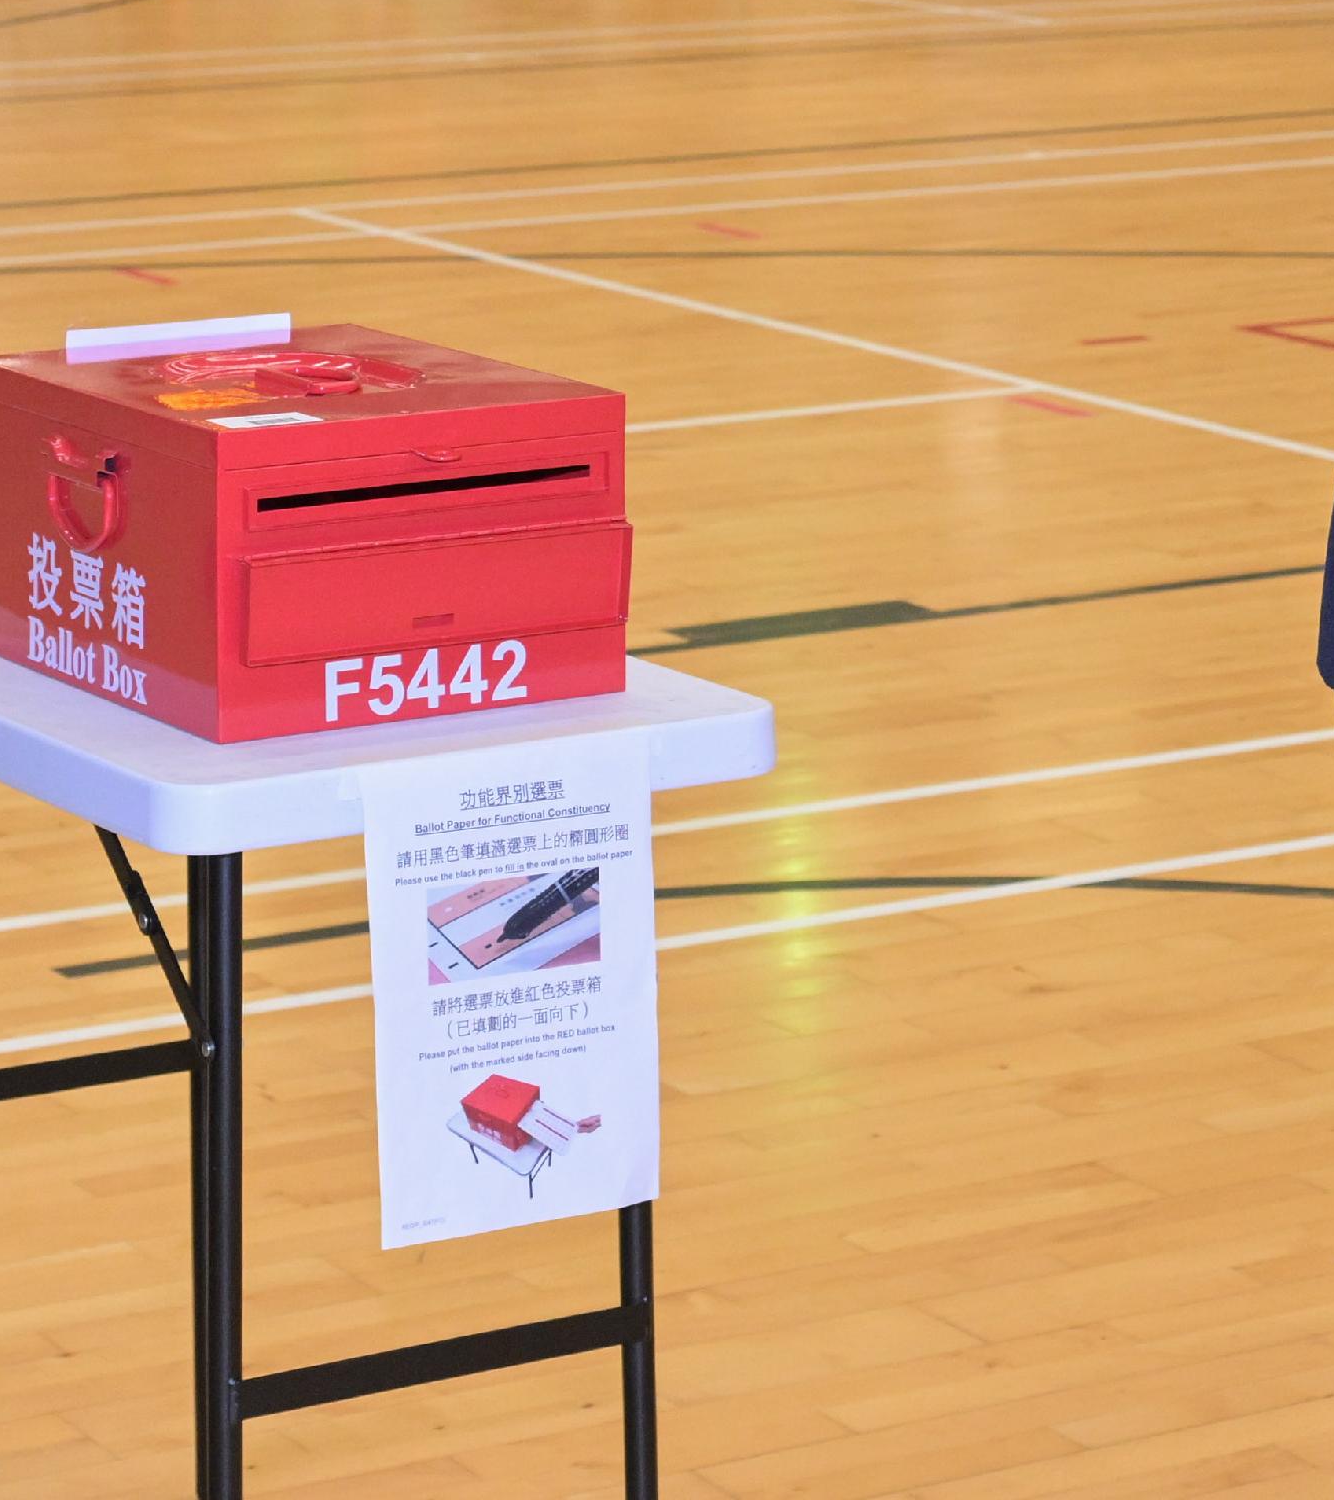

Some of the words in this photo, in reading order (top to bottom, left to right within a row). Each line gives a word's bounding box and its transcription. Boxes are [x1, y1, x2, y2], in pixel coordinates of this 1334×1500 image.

[27, 532, 147, 650] 投票箱
[27, 615, 97, 686] Ballot
[101, 644, 148, 705] Box
[324, 639, 528, 722] F5442
[459, 779, 565, 809] 功能界別選票
[414, 821, 445, 835] Ballot
[446, 818, 476, 832] Paper
[478, 816, 492, 826] for
[494, 810, 546, 825] Functional
[547, 802, 611, 818] Constituency
[395, 877, 422, 887] Please
[440, 872, 454, 881] the
[456, 868, 476, 879] black
[478, 868, 492, 876] pen
[505, 864, 516, 872] fill
[526, 861, 539, 870] the
[540, 858, 558, 868] oval
[572, 856, 585, 864] the
[586, 851, 609, 862] ballot
[610, 850, 633, 860] paper
[432, 976, 602, 1017] 請將選票放進紅色投票箱
[418, 1050, 446, 1061] Please
[448, 1048, 460, 1058] put
[462, 1046, 475, 1055] the
[477, 1041, 499, 1052] ballot
[500, 1038, 523, 1050] paper
[524, 1035, 540, 1044] into
[542, 1032, 556, 1041] the
[557, 1030, 575, 1039] RED
[576, 1026, 600, 1036] ballot
[601, 1024, 616, 1033] box
[450, 1062, 469, 1074] (with
[471, 1060, 484, 1070] the
[486, 1056, 515, 1067] marked
[517, 1052, 534, 1062] side
[536, 1048, 560, 1060] facing
[562, 1044, 587, 1056] down)
